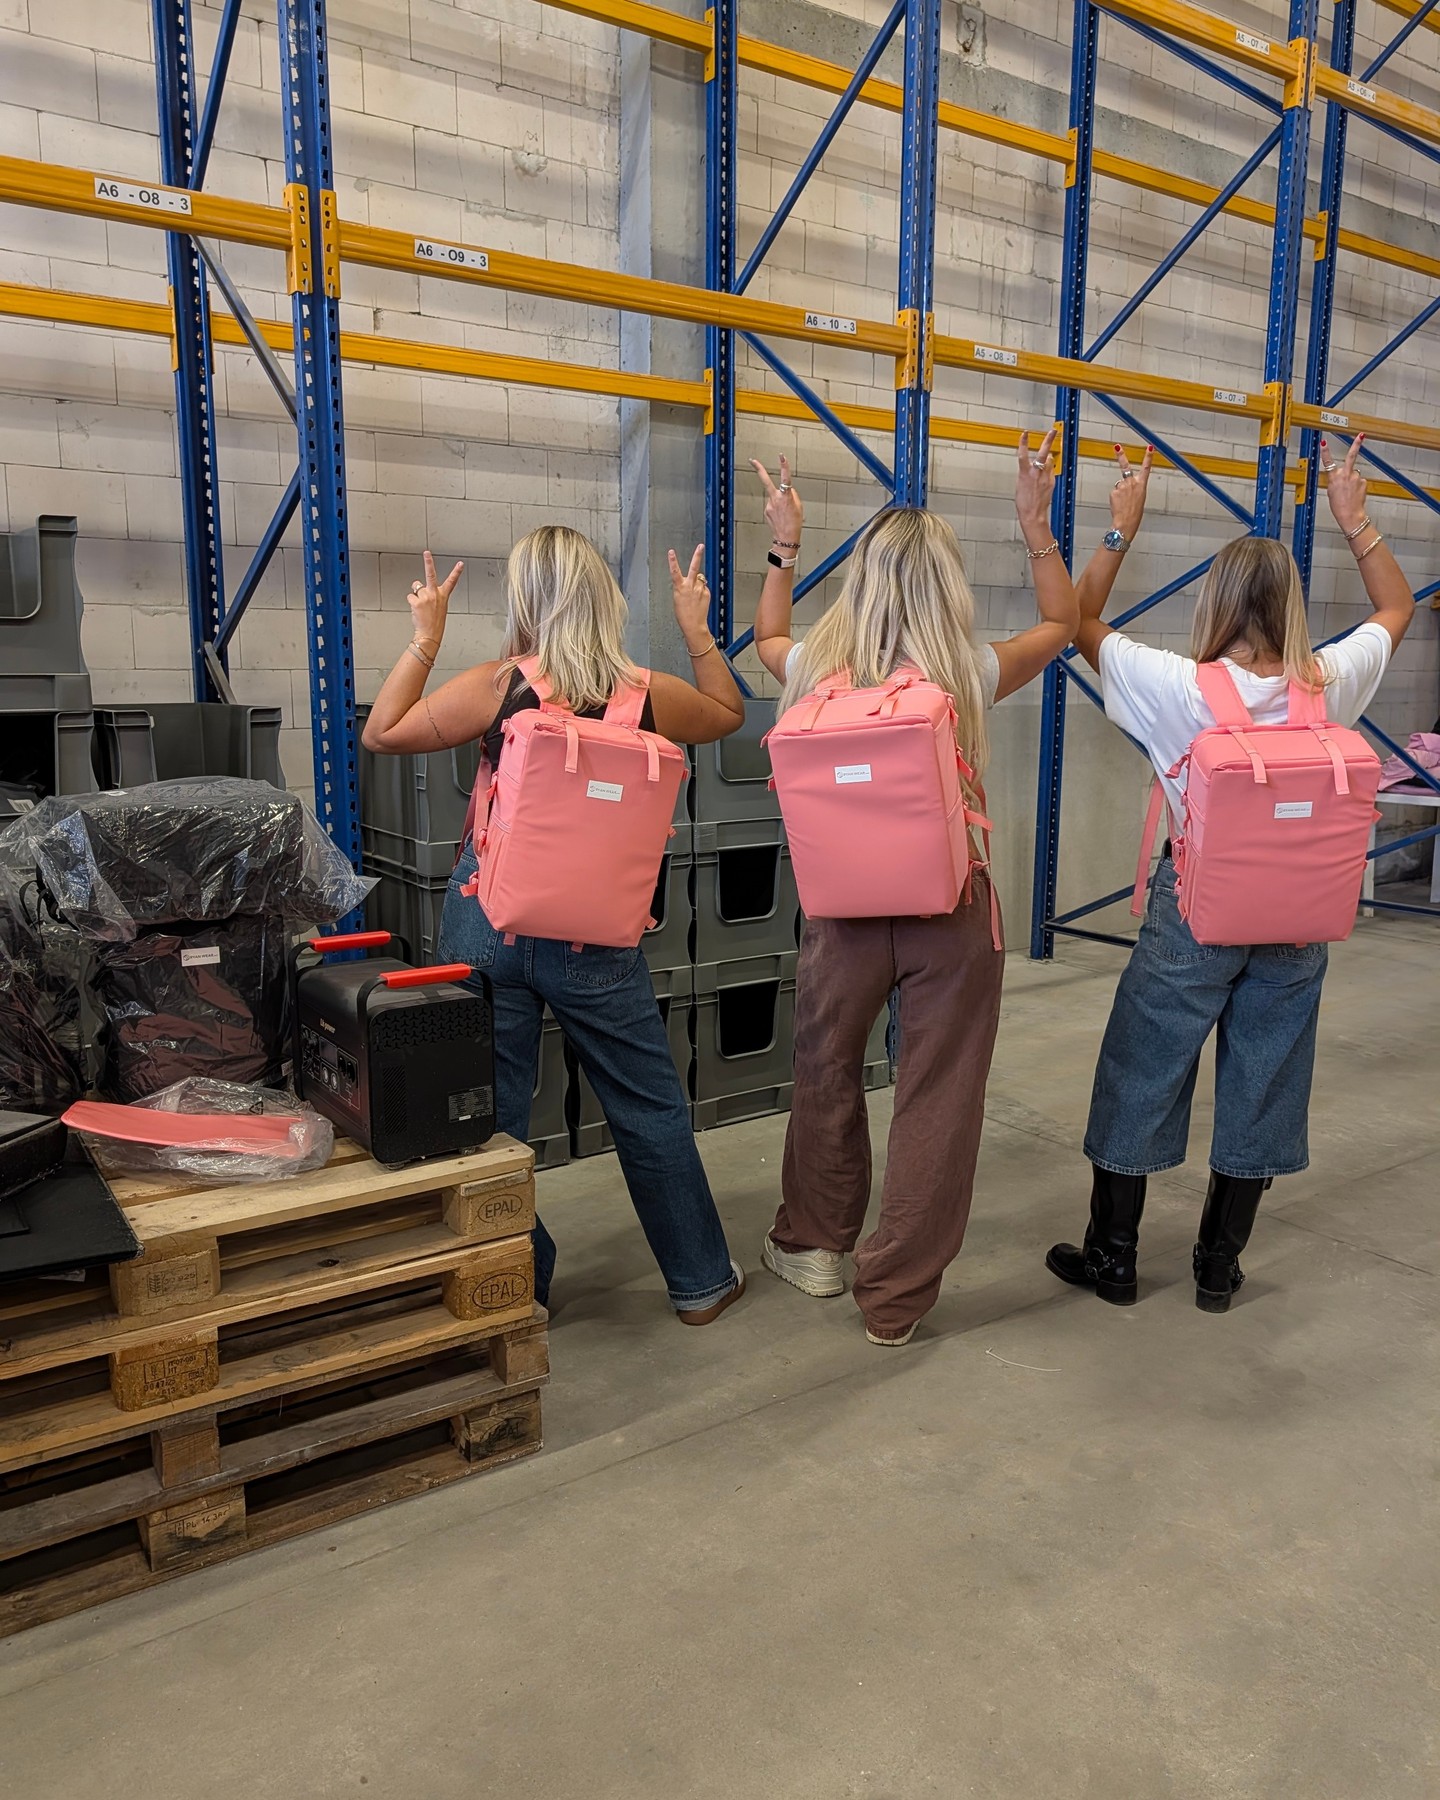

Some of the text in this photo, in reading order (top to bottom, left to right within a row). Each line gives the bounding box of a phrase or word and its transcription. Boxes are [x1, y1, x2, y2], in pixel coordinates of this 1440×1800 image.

[97, 182, 119, 198] A6
[180, 197, 189, 211] 3
[416, 243, 433, 257] A6
[479, 255, 487, 267] 3
[806, 315, 818, 326] A6
[829, 319, 839, 329] 10
[850, 322, 856, 332] 3
[975, 347, 985, 358] A5
[1011, 354, 1016, 364] 3
[1214, 391, 1223, 400] A5
[485, 1199, 518, 1219] EPAL
[480, 1279, 520, 1305] EPAL
